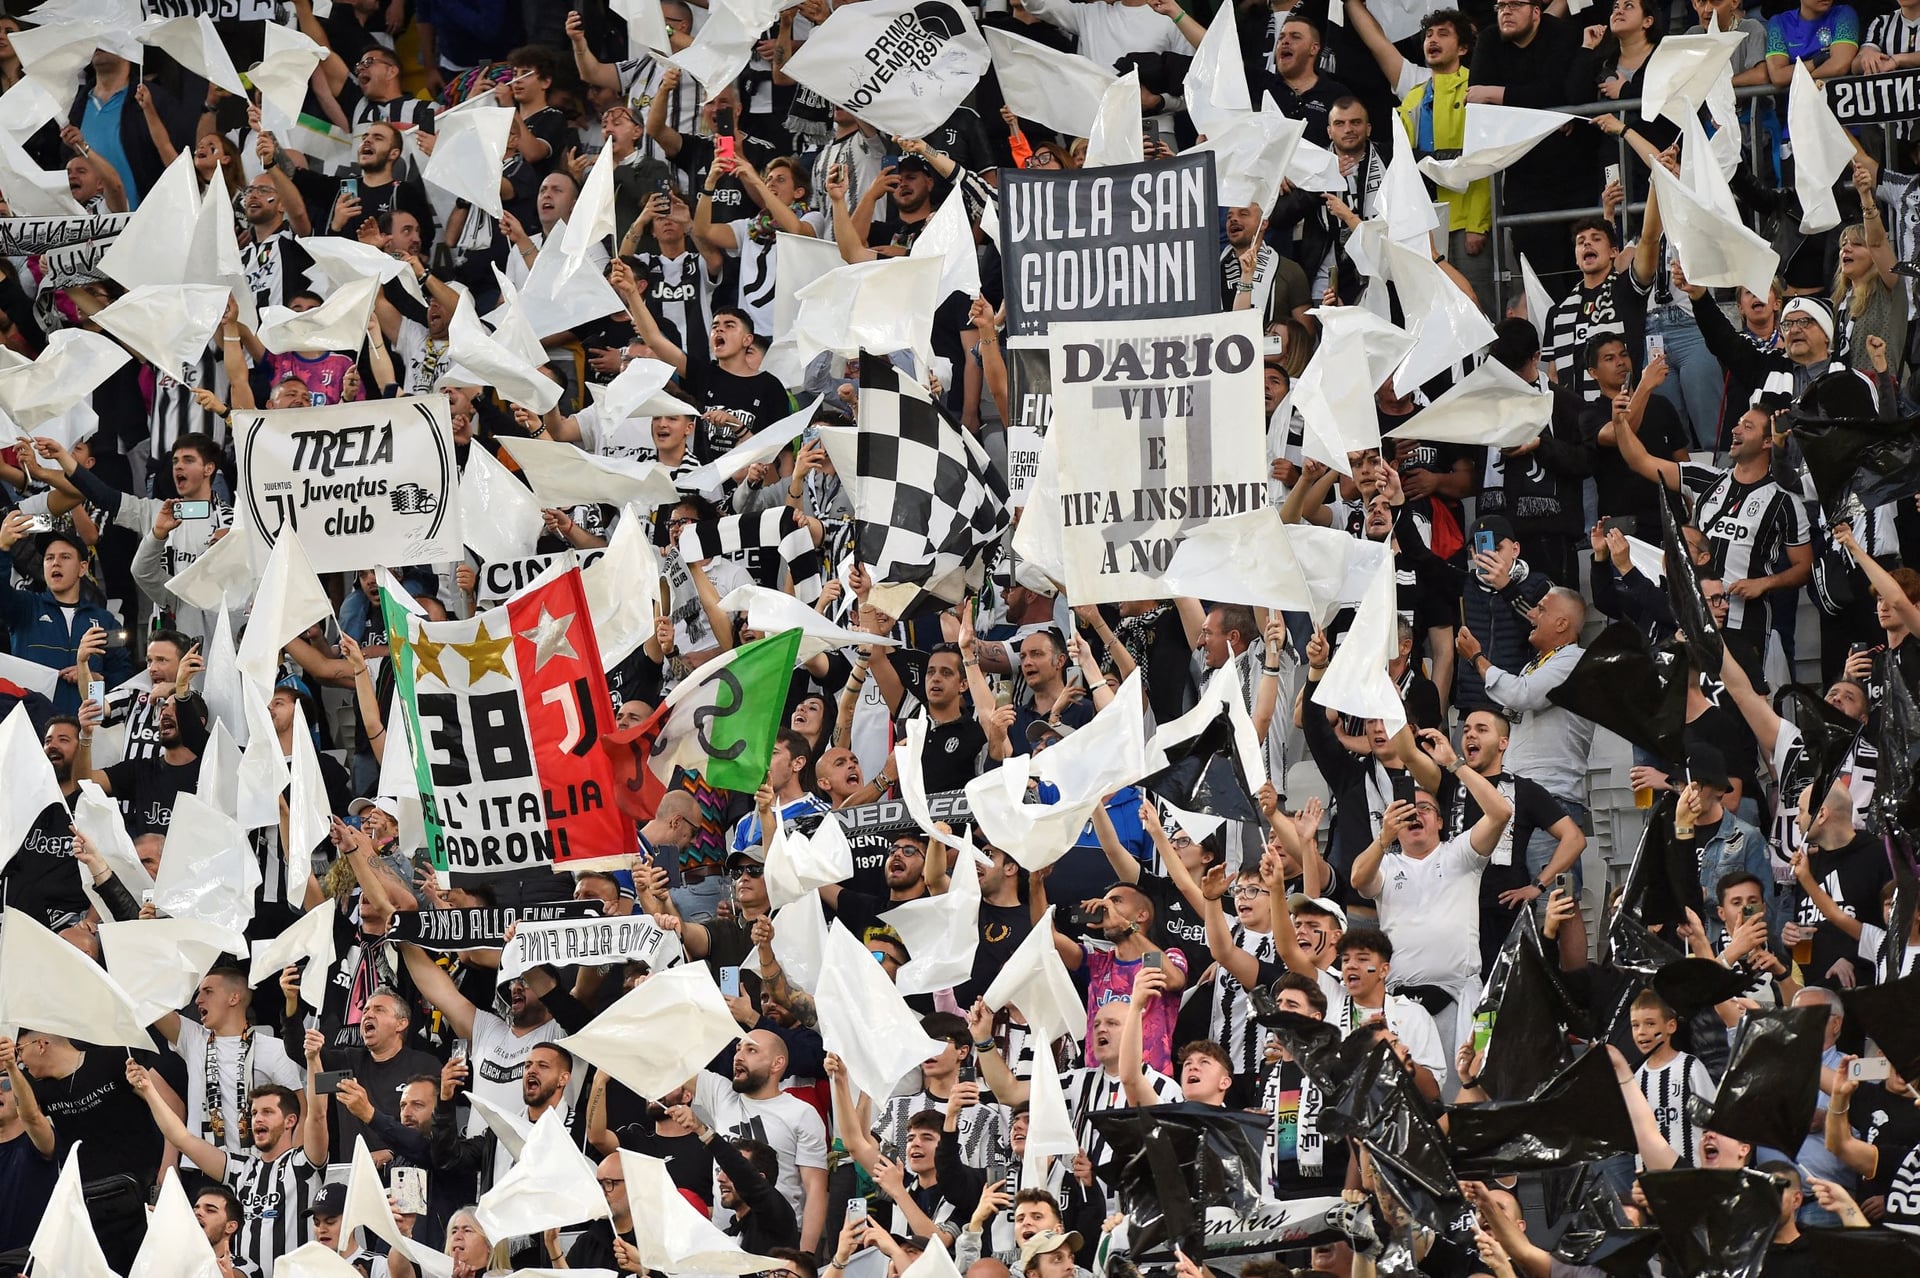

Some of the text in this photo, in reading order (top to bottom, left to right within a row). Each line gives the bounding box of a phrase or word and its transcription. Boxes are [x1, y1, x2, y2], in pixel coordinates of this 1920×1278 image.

[864, 12, 917, 66] PRIMO
[908, 36, 948, 77] 1897
[843, 28, 929, 114] NOVEMBRE
[1008, 166, 1206, 243] VILLA SAN
[651, 281, 696, 301] Jeep
[1020, 240, 1197, 314] GIOVANNI
[1062, 333, 1255, 384] DARIO
[1119, 385, 1194, 420] VIVE
[292, 418, 393, 477] TREIA
[1148, 436, 1168, 471] E
[264, 482, 292, 493] JUVENTUS
[300, 479, 387, 508] Juventus
[1060, 482, 1269, 528] TIFA INSIEME
[325, 505, 376, 537] club
[1100, 541, 1119, 575] A
[417, 689, 533, 787] 38
[836, 797, 970, 829] NEDED
[25, 828, 76, 857] Jeep
[434, 827, 571, 868] PADRONI
[855, 854, 884, 869] 1897
[418, 910, 464, 941] FINO
[481, 1061, 501, 1080] BLACK
[242, 1192, 281, 1207] Jeep
